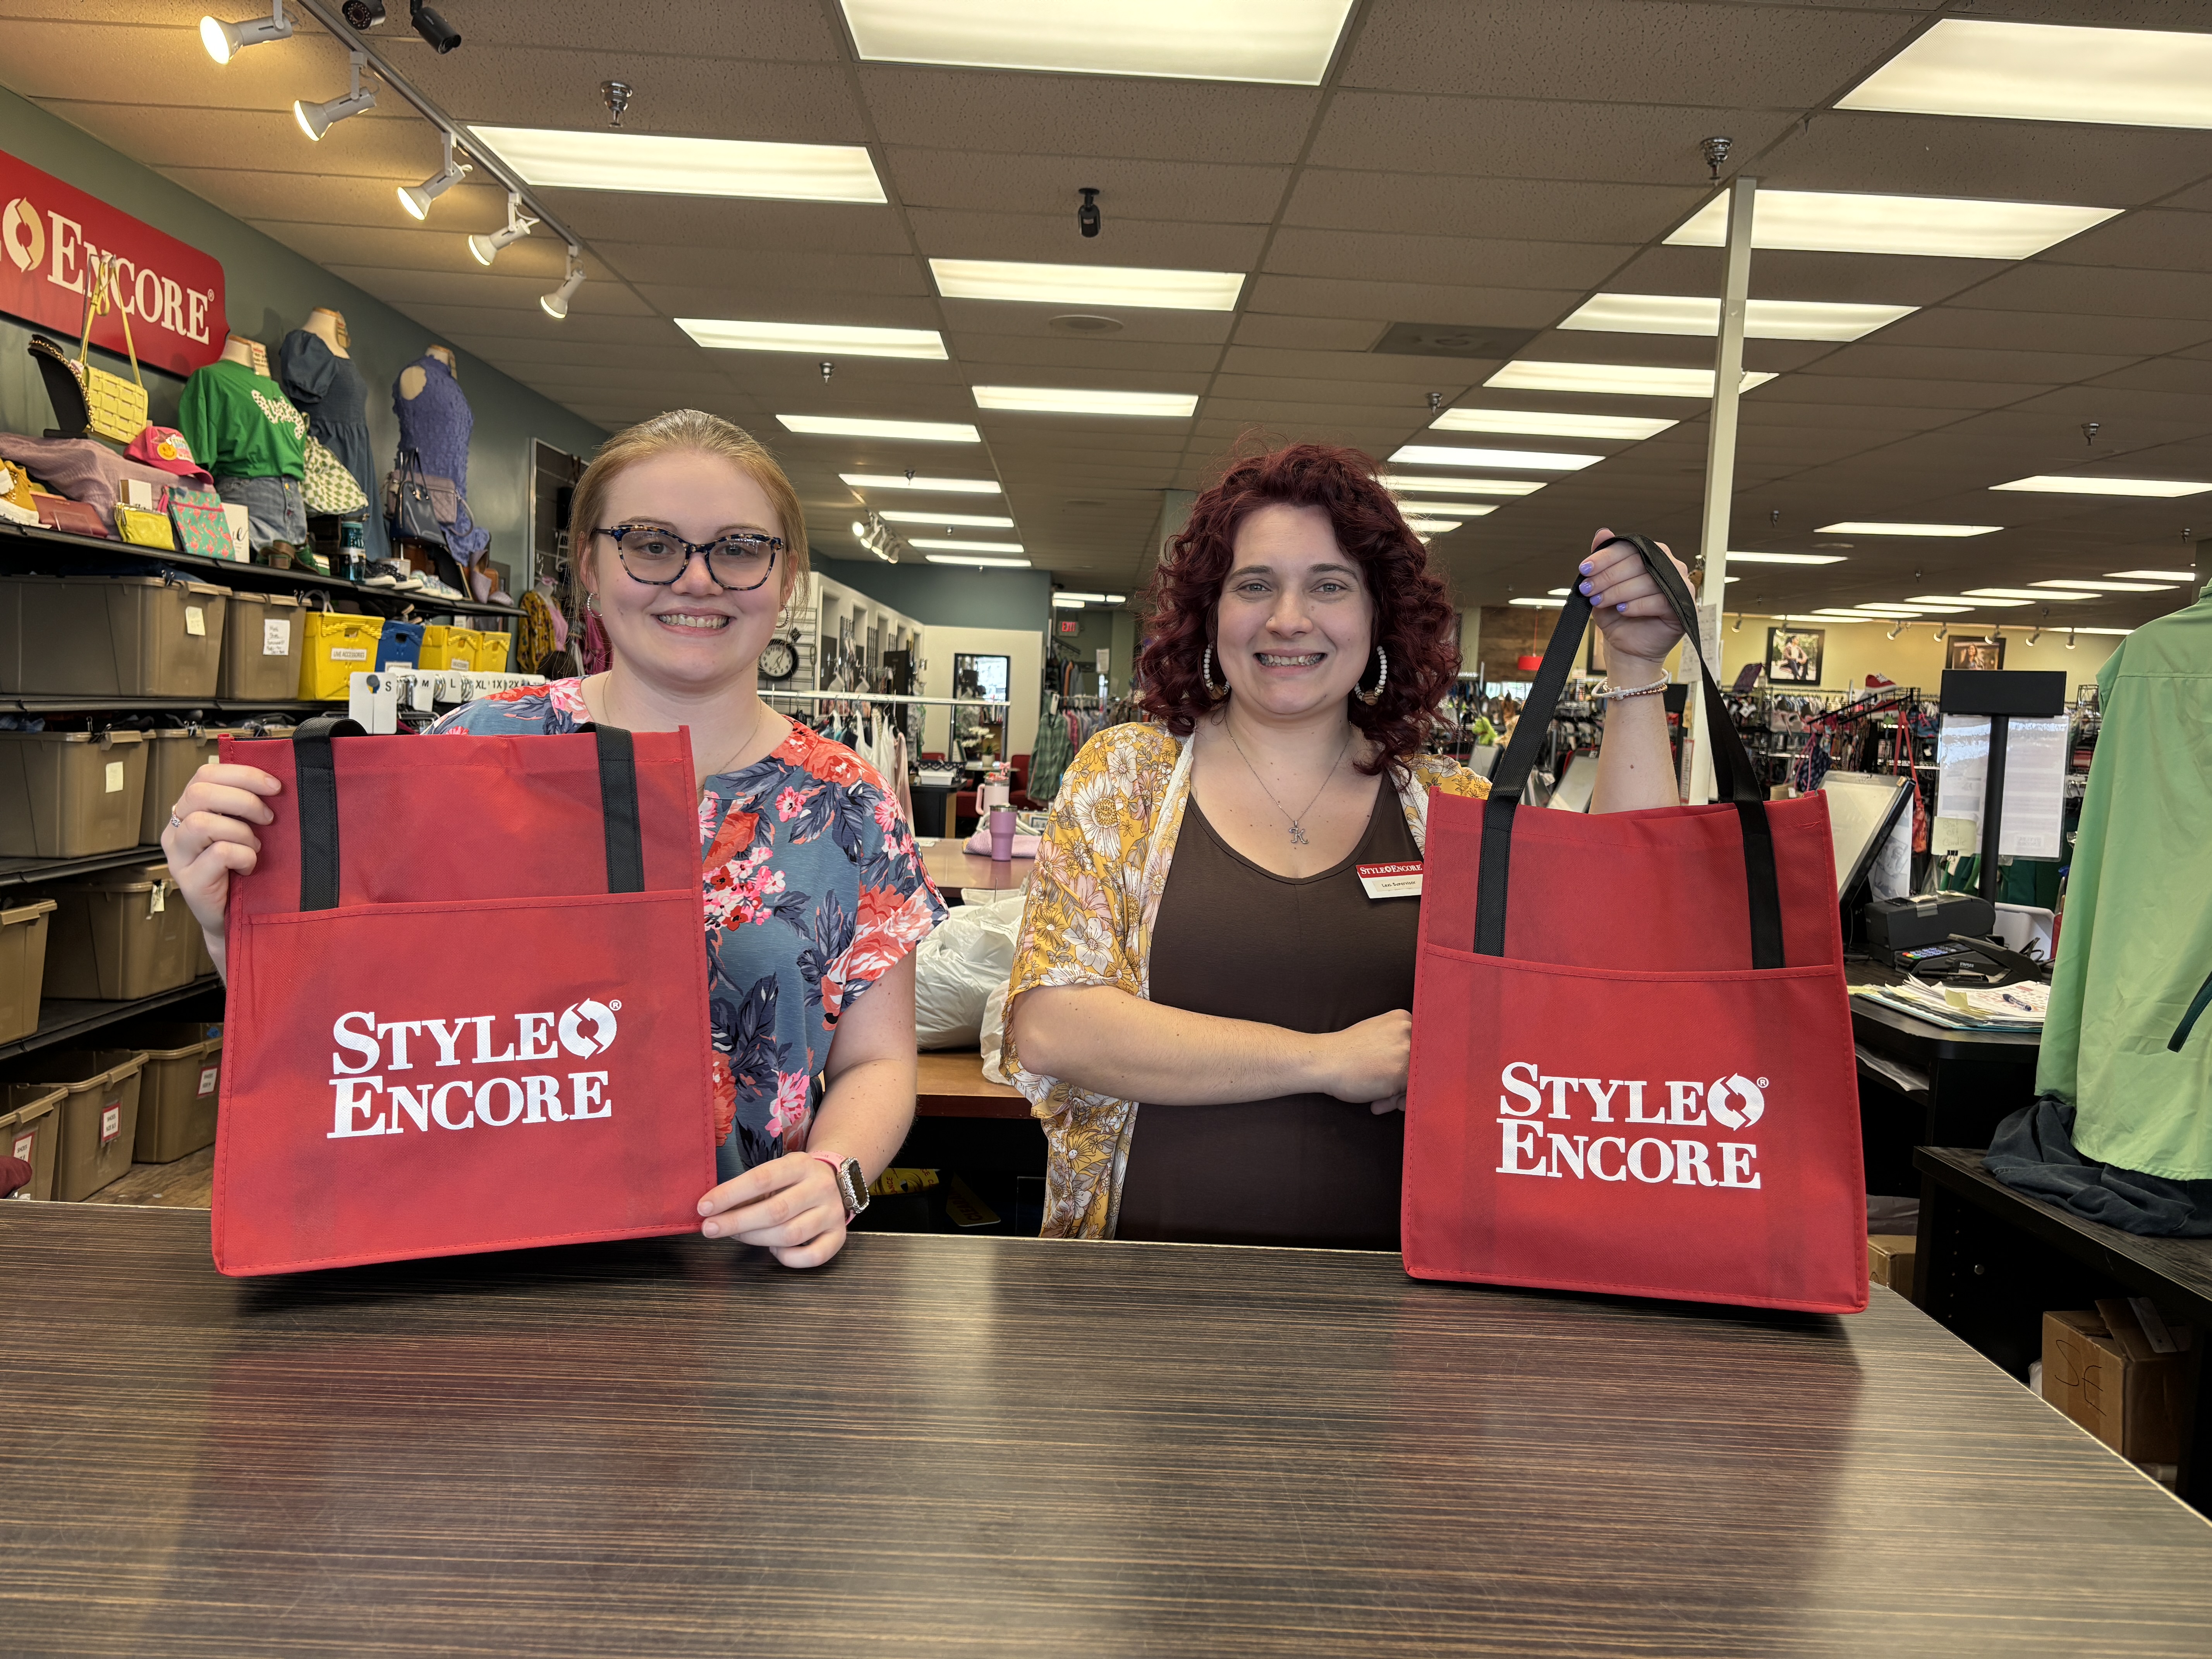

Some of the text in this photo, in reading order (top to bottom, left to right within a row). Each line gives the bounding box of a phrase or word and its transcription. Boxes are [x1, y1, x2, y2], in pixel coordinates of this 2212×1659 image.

[1062, 621, 1076, 632] EXIT
[385, 681, 391, 692] S
[451, 678, 456, 688] L
[476, 680, 486, 690] XL
[492, 680, 503, 689] 1X
[1360, 867, 1386, 875] STYLE
[332, 1011, 558, 1075] STYLE
[1500, 1061, 1707, 1126] STYLE
[326, 1070, 612, 1139] ENCORE
[1496, 1117, 1761, 1189] ENCORE
[2054, 1339, 2107, 1417] SE
